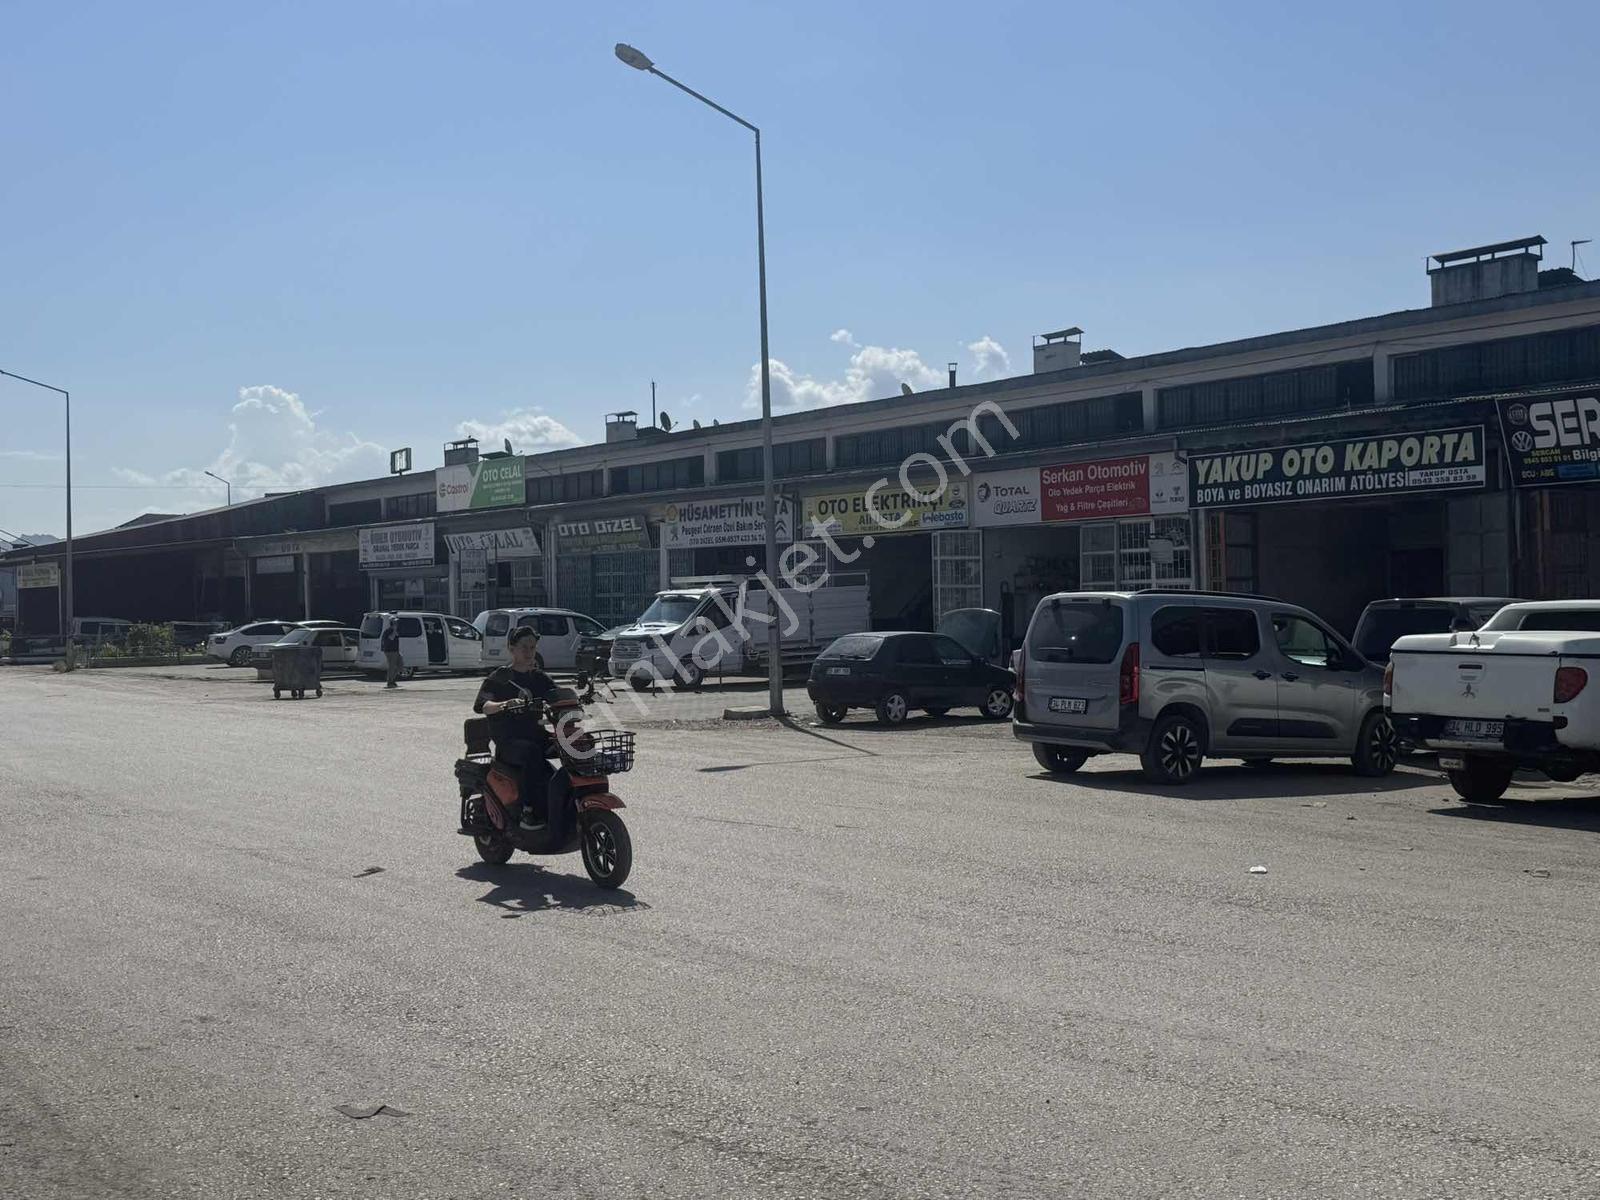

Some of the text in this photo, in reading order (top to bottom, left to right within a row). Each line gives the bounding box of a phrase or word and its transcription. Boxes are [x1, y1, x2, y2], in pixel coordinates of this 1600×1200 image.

[1195, 432, 1476, 485] YAKUP OTO KAPORTA
[483, 463, 522, 482] OTO CELAL
[1042, 460, 1146, 485] Serkan Otomotiv
[1419, 467, 1470, 479] YAKUP USTA
[447, 482, 470, 496] Castrol
[993, 485, 1030, 496] TOTAL
[1048, 480, 1136, 497] Oto Yedek Parça Elektrik
[1197, 467, 1409, 504] BOYA ve BOYASIZ ONARIM ATÖLYESİ
[680, 498, 789, 522] HÜSAMETTİN UTA
[818, 499, 849, 516] OTO
[994, 499, 1038, 515] QUARTZ
[1077, 501, 1096, 511] Filtre
[557, 518, 642, 536] OTO DİZEL
